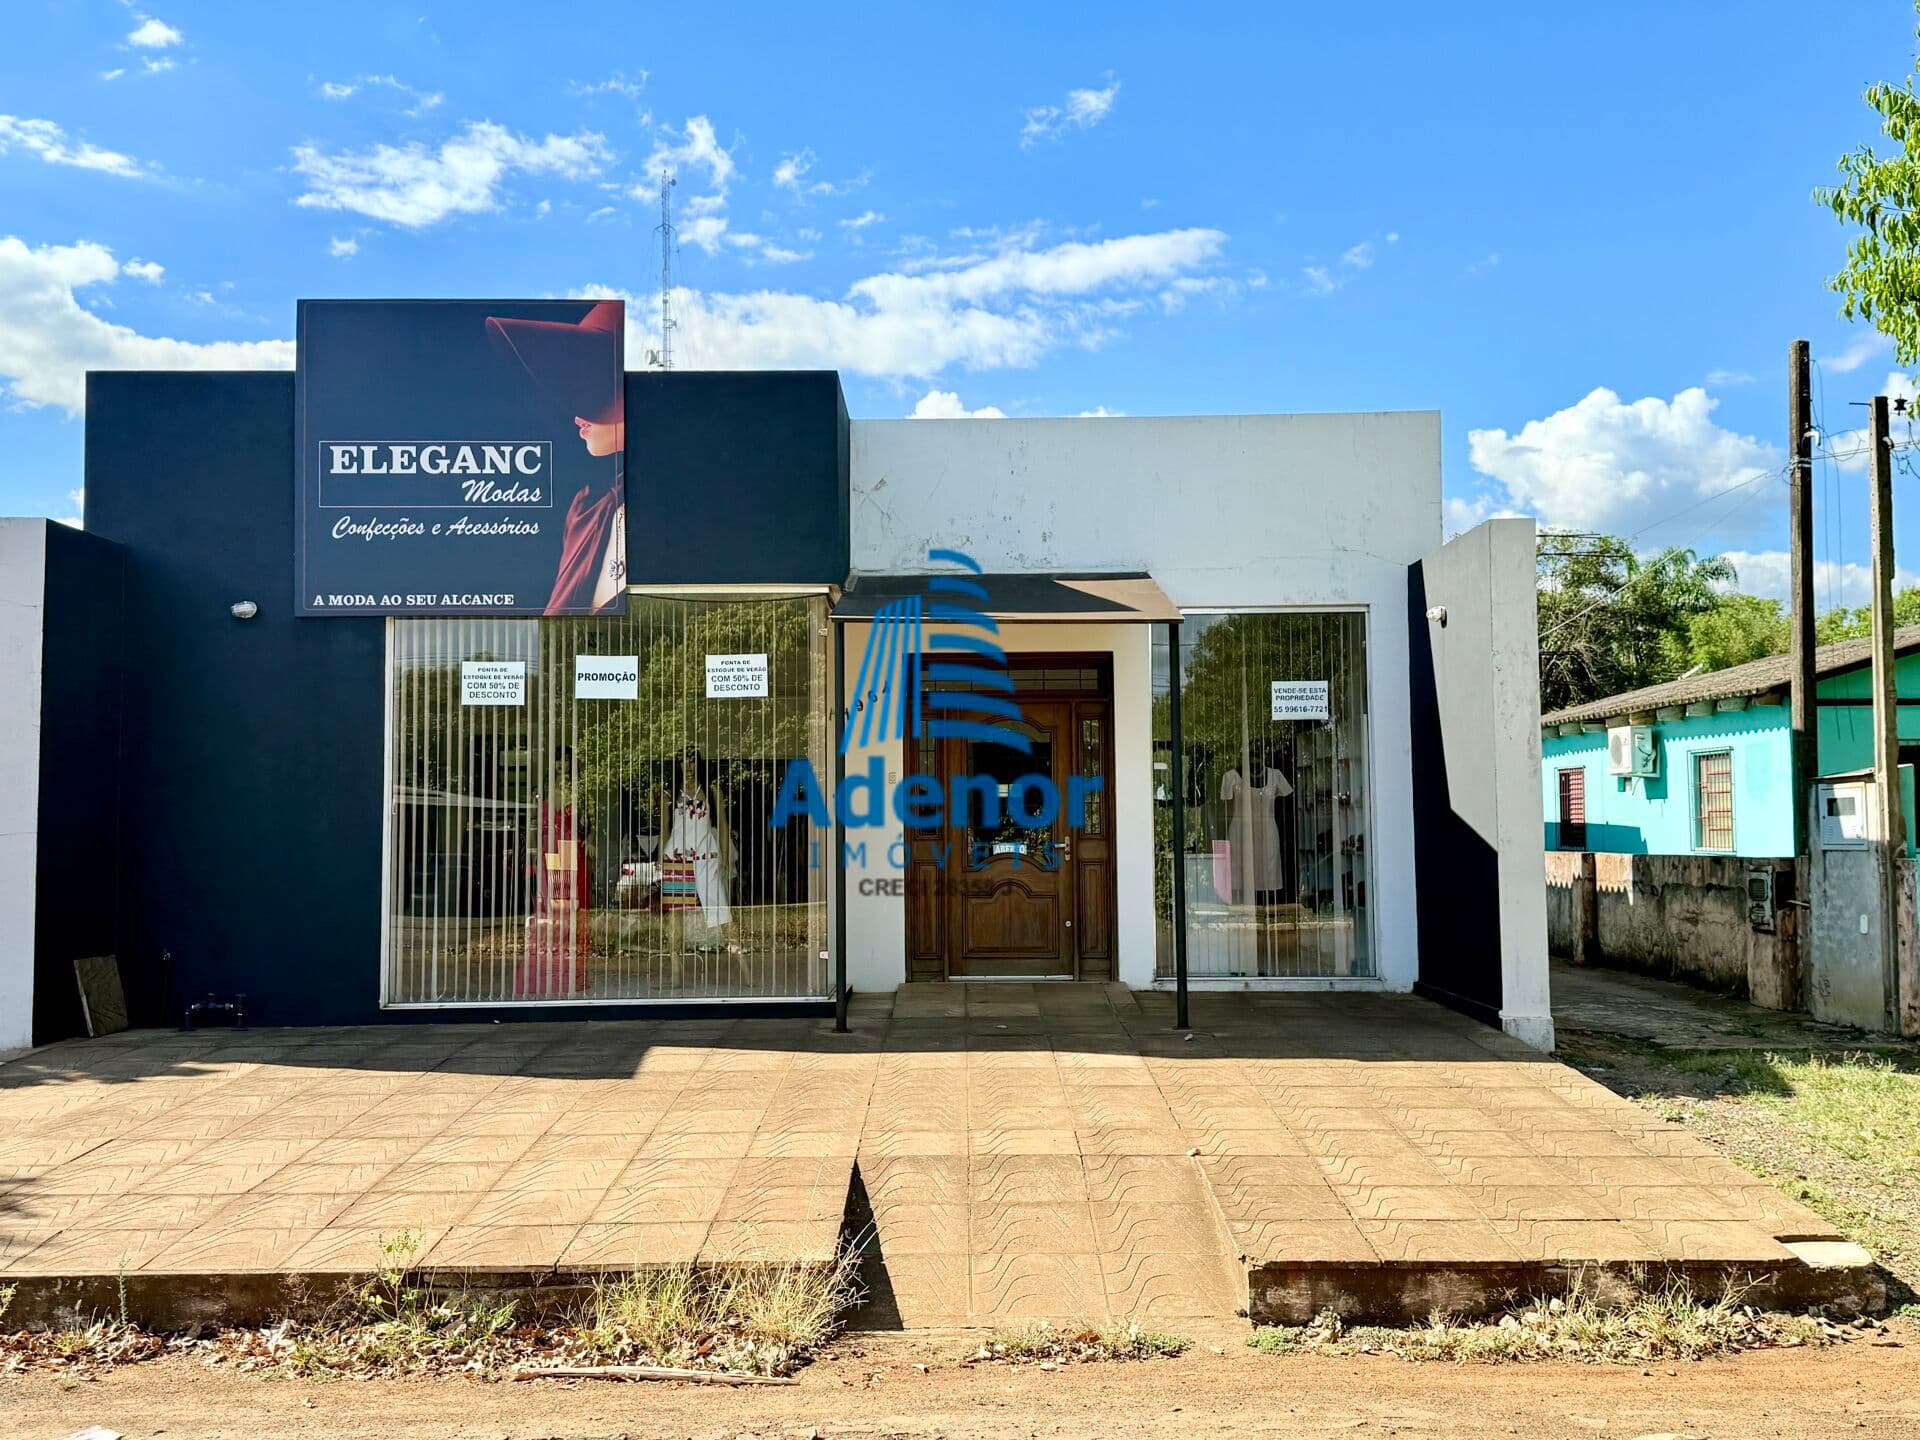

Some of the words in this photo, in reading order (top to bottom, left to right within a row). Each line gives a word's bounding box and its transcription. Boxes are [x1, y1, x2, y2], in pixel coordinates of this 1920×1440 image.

[329, 445, 542, 474] ELEGANC
[461, 479, 542, 503] Modas
[332, 515, 426, 541] Confecções
[431, 523, 442, 536] e
[445, 515, 540, 536] Acessórios
[313, 594, 325, 606] A
[328, 594, 377, 606] MODA
[380, 594, 402, 606] AO
[406, 594, 438, 606] SEU
[441, 594, 514, 605] ALCANCE
[577, 671, 636, 683] PROMOÇÃO
[711, 675, 731, 683] COM
[732, 674, 750, 682] 50%
[751, 674, 763, 682] DE
[508, 682, 520, 690] DE
[713, 683, 761, 692] DESCONTO
[469, 691, 517, 699] DESCONTO
[1273, 705, 1284, 713] 55
